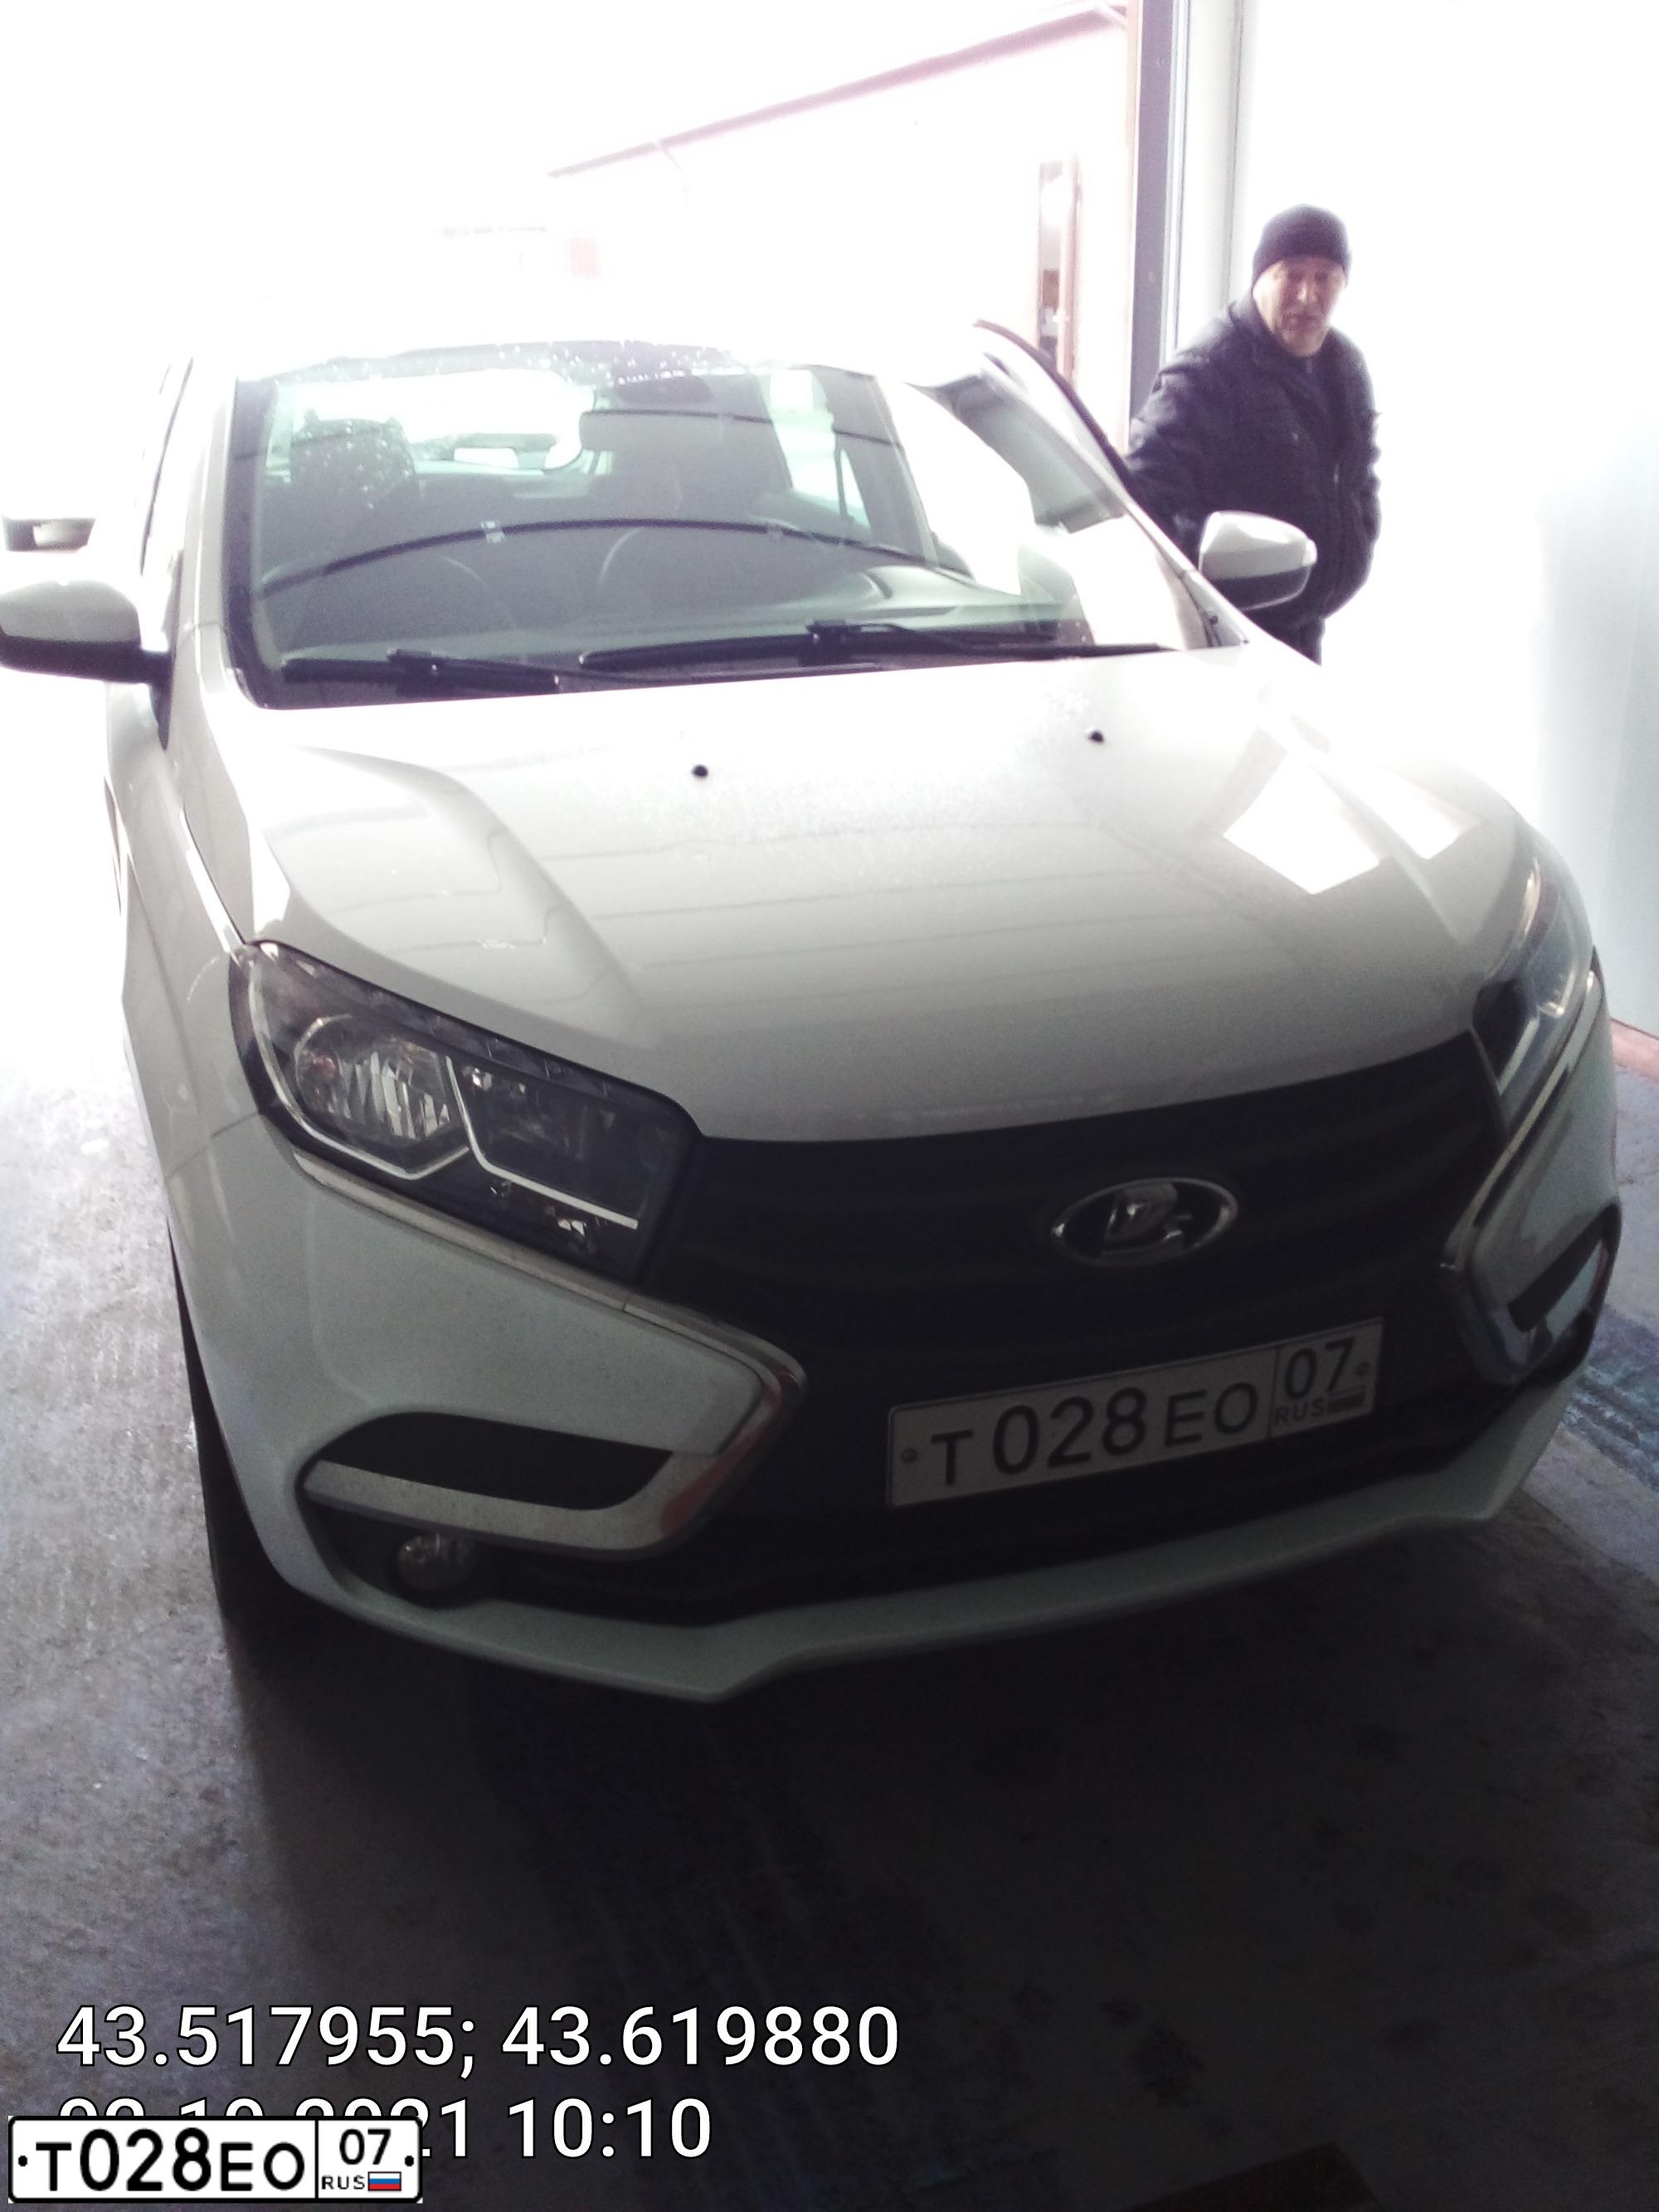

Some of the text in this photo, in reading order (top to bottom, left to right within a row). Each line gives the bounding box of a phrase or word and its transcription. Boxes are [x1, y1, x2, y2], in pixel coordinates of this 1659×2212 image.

[1283, 1337, 1355, 1400] 07
[931, 1382, 1258, 1485] T028EO
[1276, 1398, 1326, 1426] RUS
